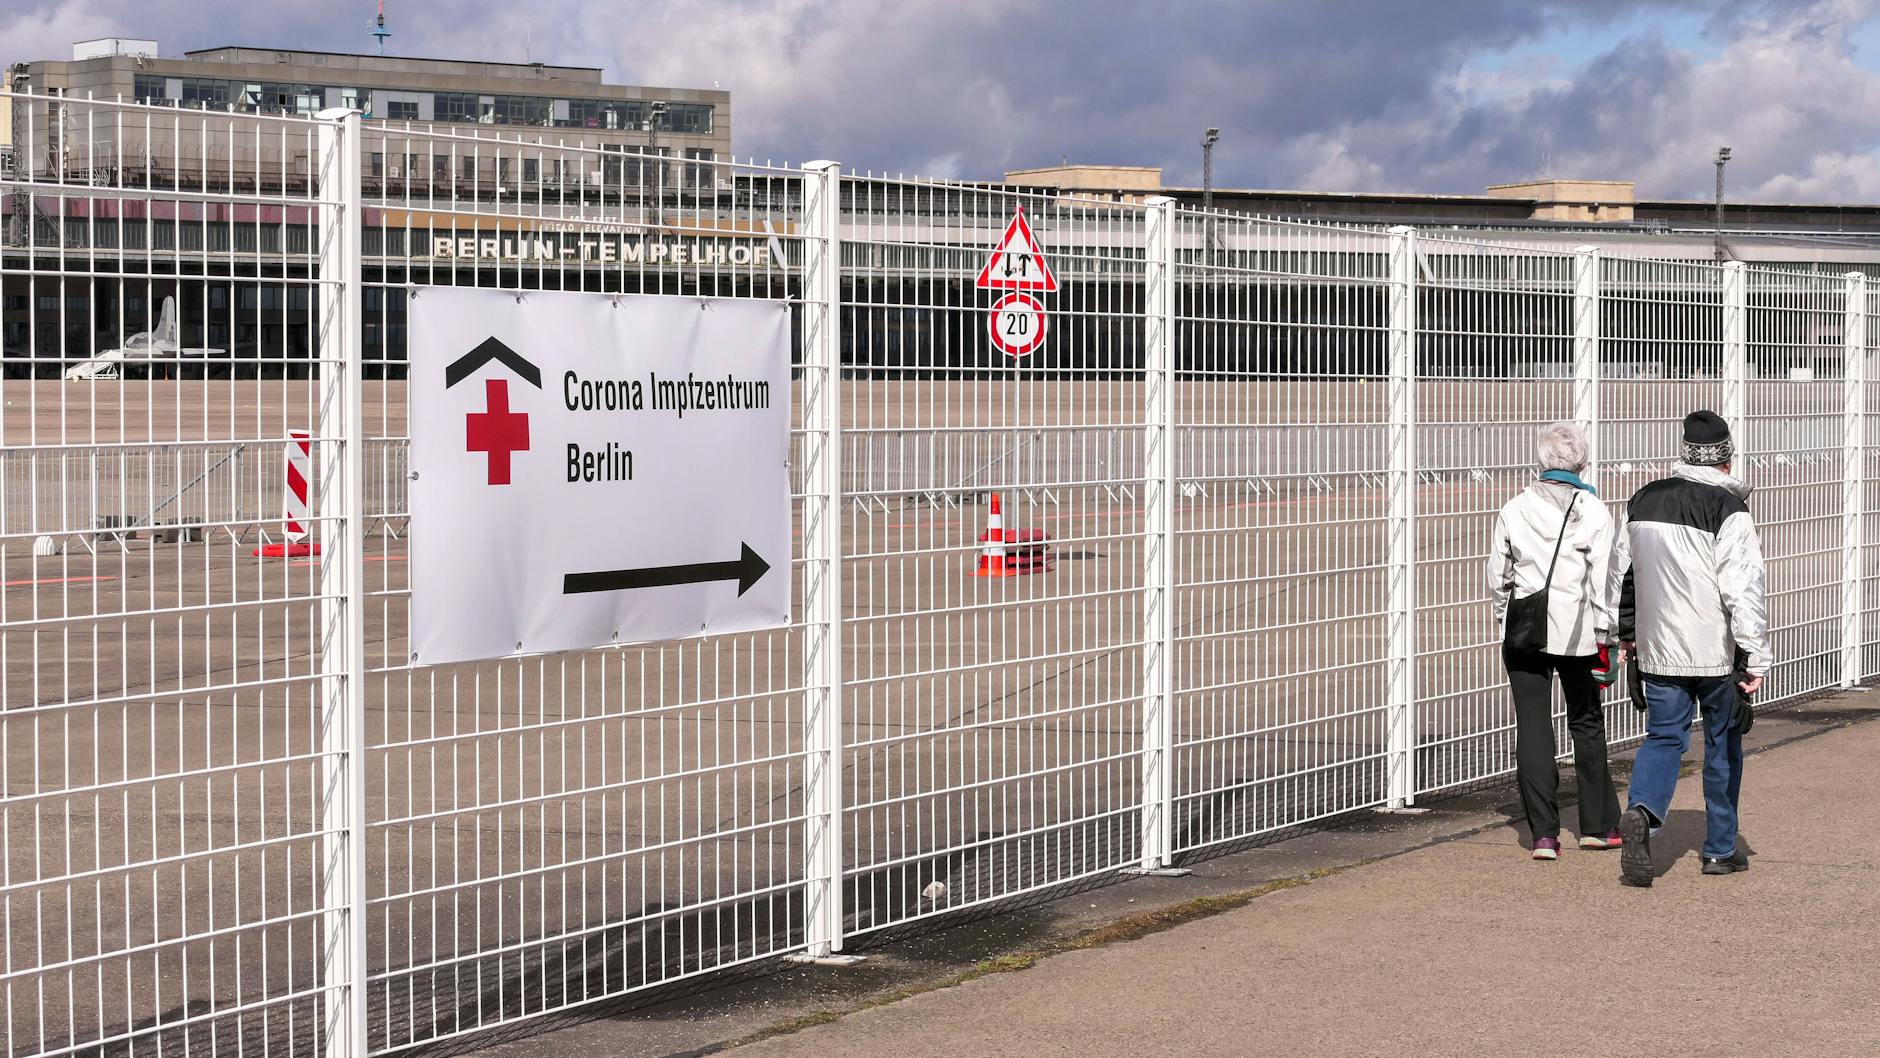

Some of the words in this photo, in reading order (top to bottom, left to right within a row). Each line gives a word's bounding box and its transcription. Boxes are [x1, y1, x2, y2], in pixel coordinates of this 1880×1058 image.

[545, 223, 575, 232] FIELD
[1006, 313, 1028, 335] 20
[564, 370, 643, 411] Corona
[650, 372, 770, 419] Impfzentrum
[567, 443, 633, 482] Berlin
